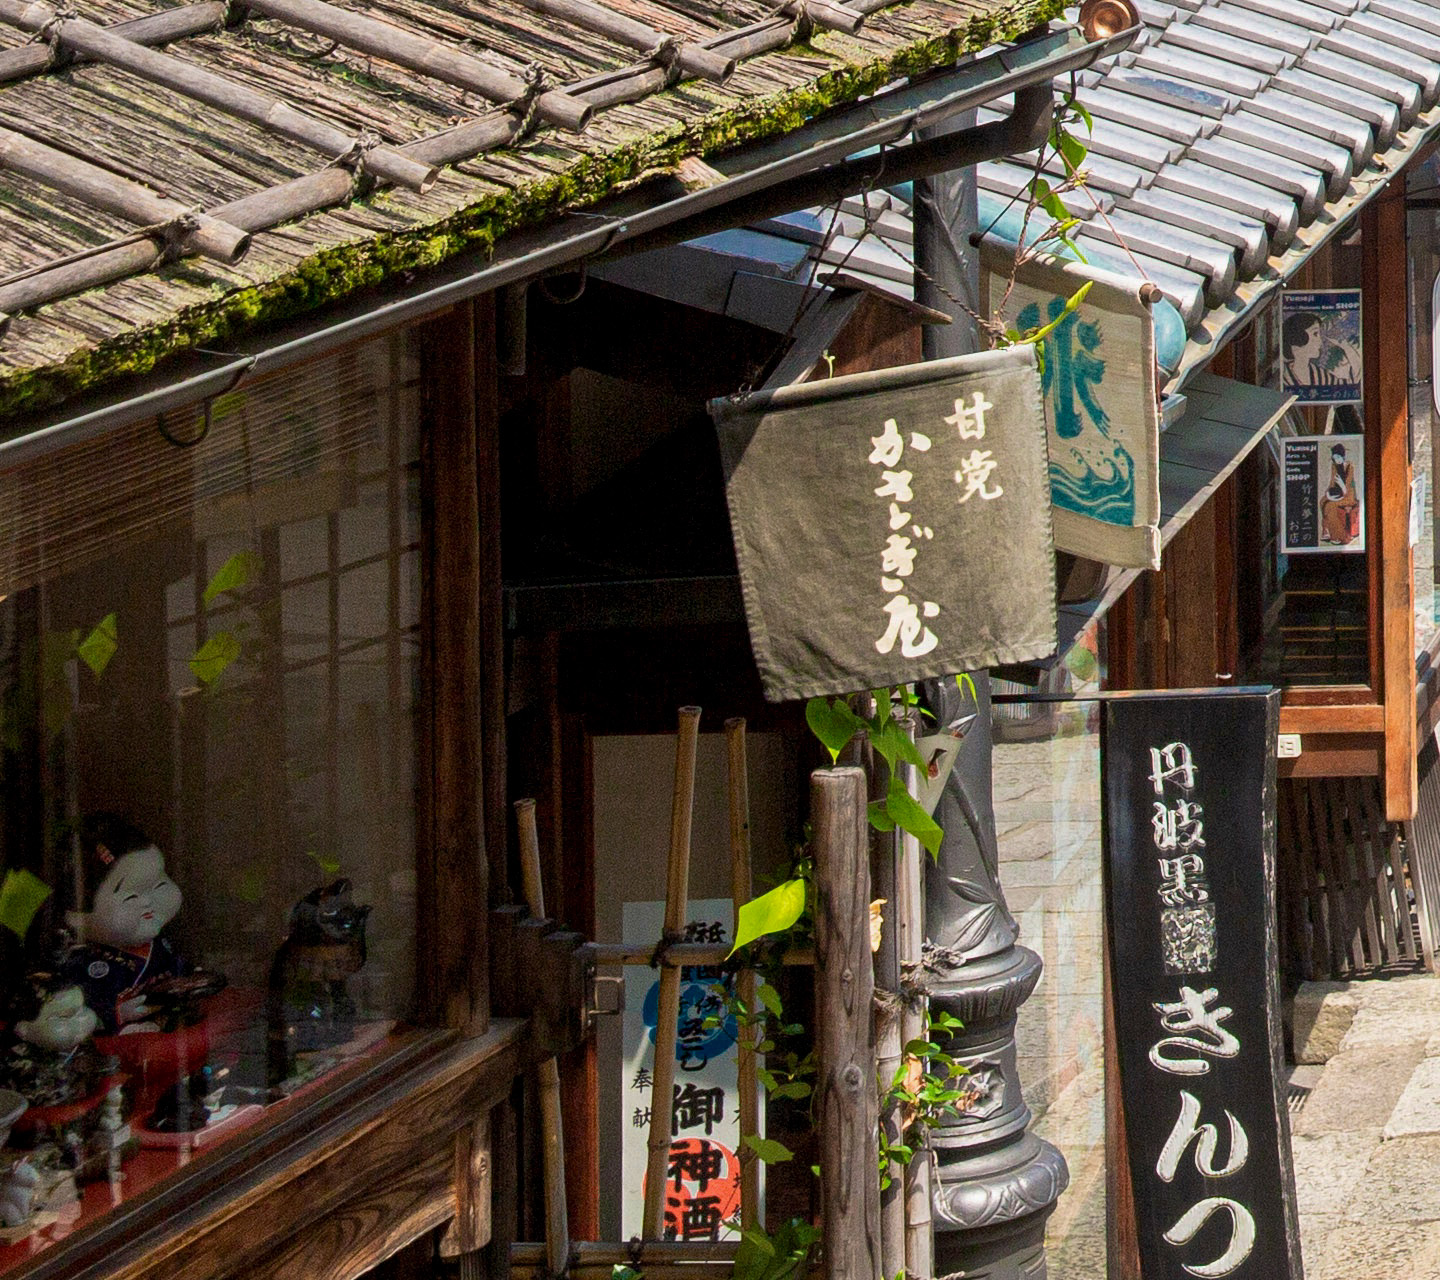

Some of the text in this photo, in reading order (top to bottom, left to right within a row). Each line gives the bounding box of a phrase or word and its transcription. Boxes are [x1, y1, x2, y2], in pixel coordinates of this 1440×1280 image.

[1015, 295, 1111, 440] 氷
[1335, 302, 1360, 310] SHOP
[943, 391, 1004, 503] 甘党
[1289, 520, 1300, 544] お店
[1148, 741, 1217, 975] 丹波黒
[663, 1083, 726, 1241] 御神酒
